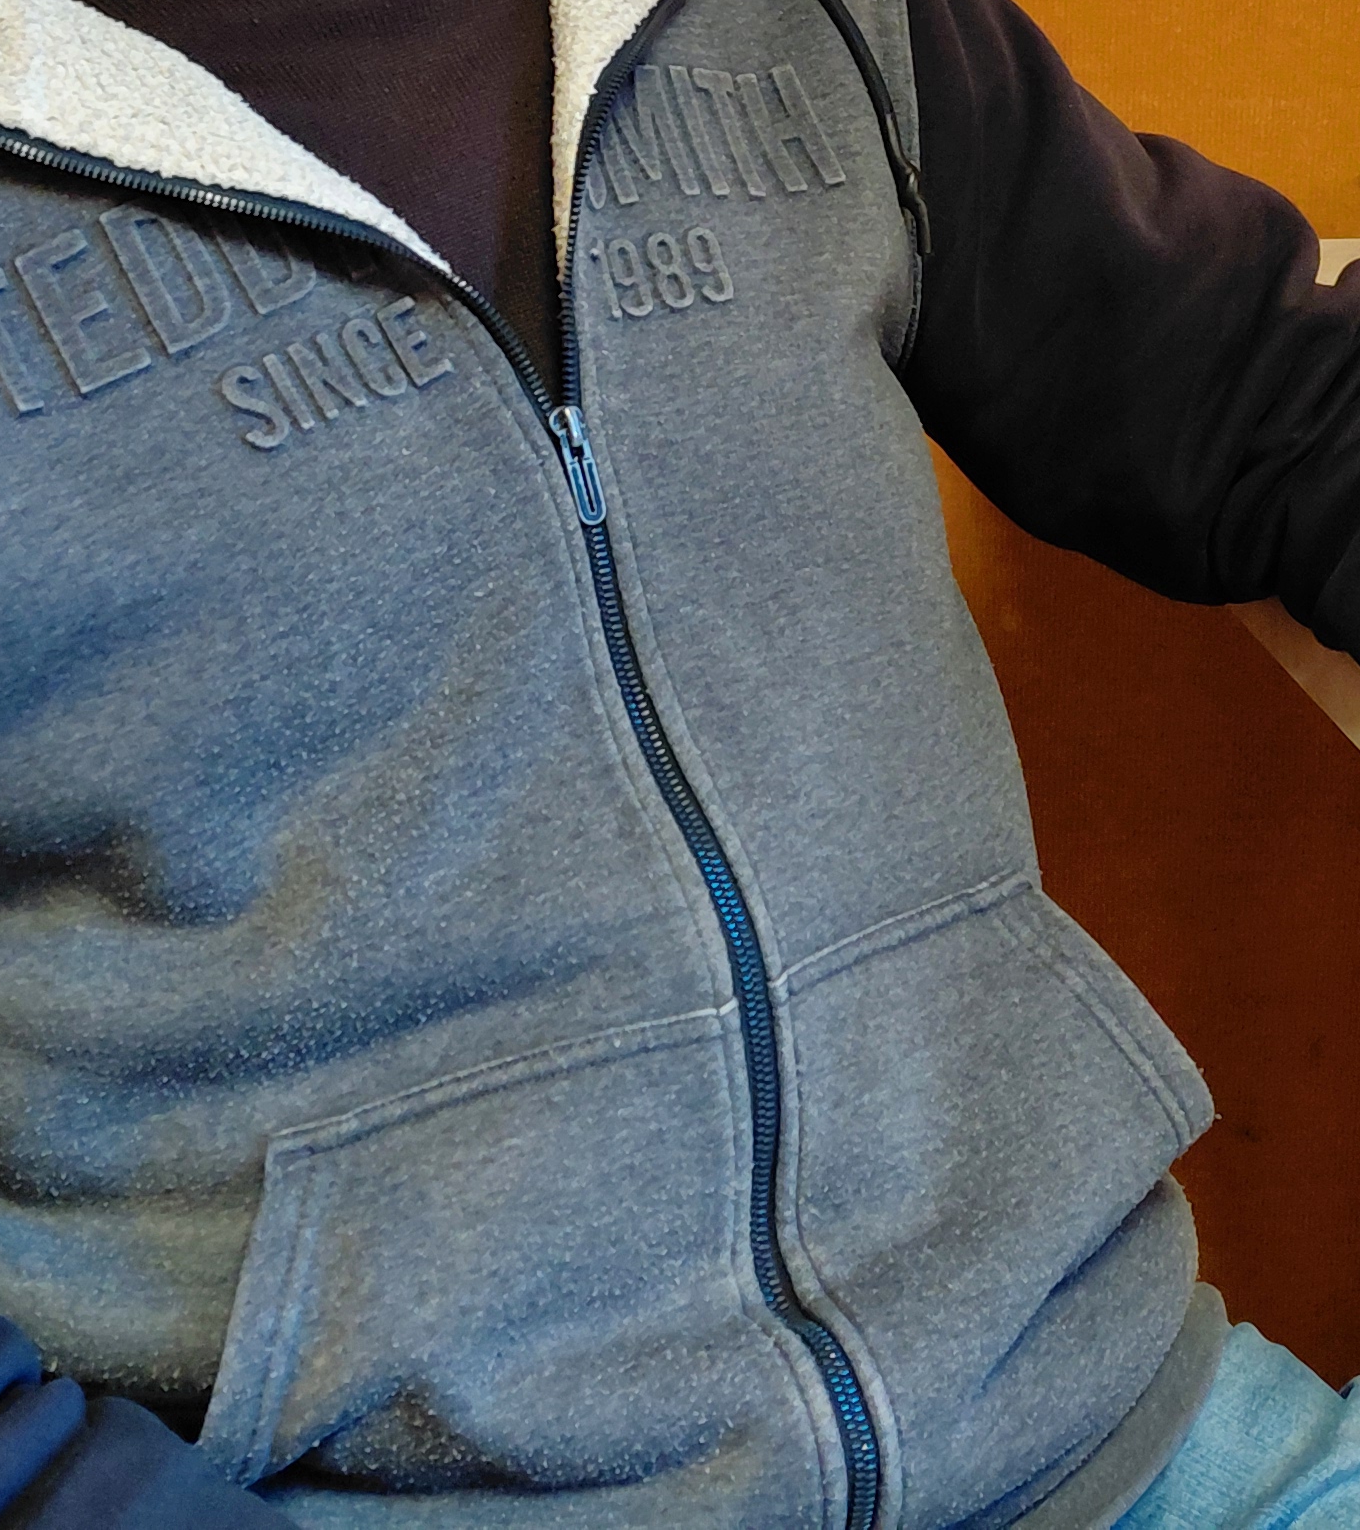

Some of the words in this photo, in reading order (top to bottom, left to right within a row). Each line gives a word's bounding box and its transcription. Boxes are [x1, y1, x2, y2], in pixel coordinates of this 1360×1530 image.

[588, 63, 847, 210] MITH
[220, 294, 455, 451] SINCE
[588, 226, 735, 319] 1989
